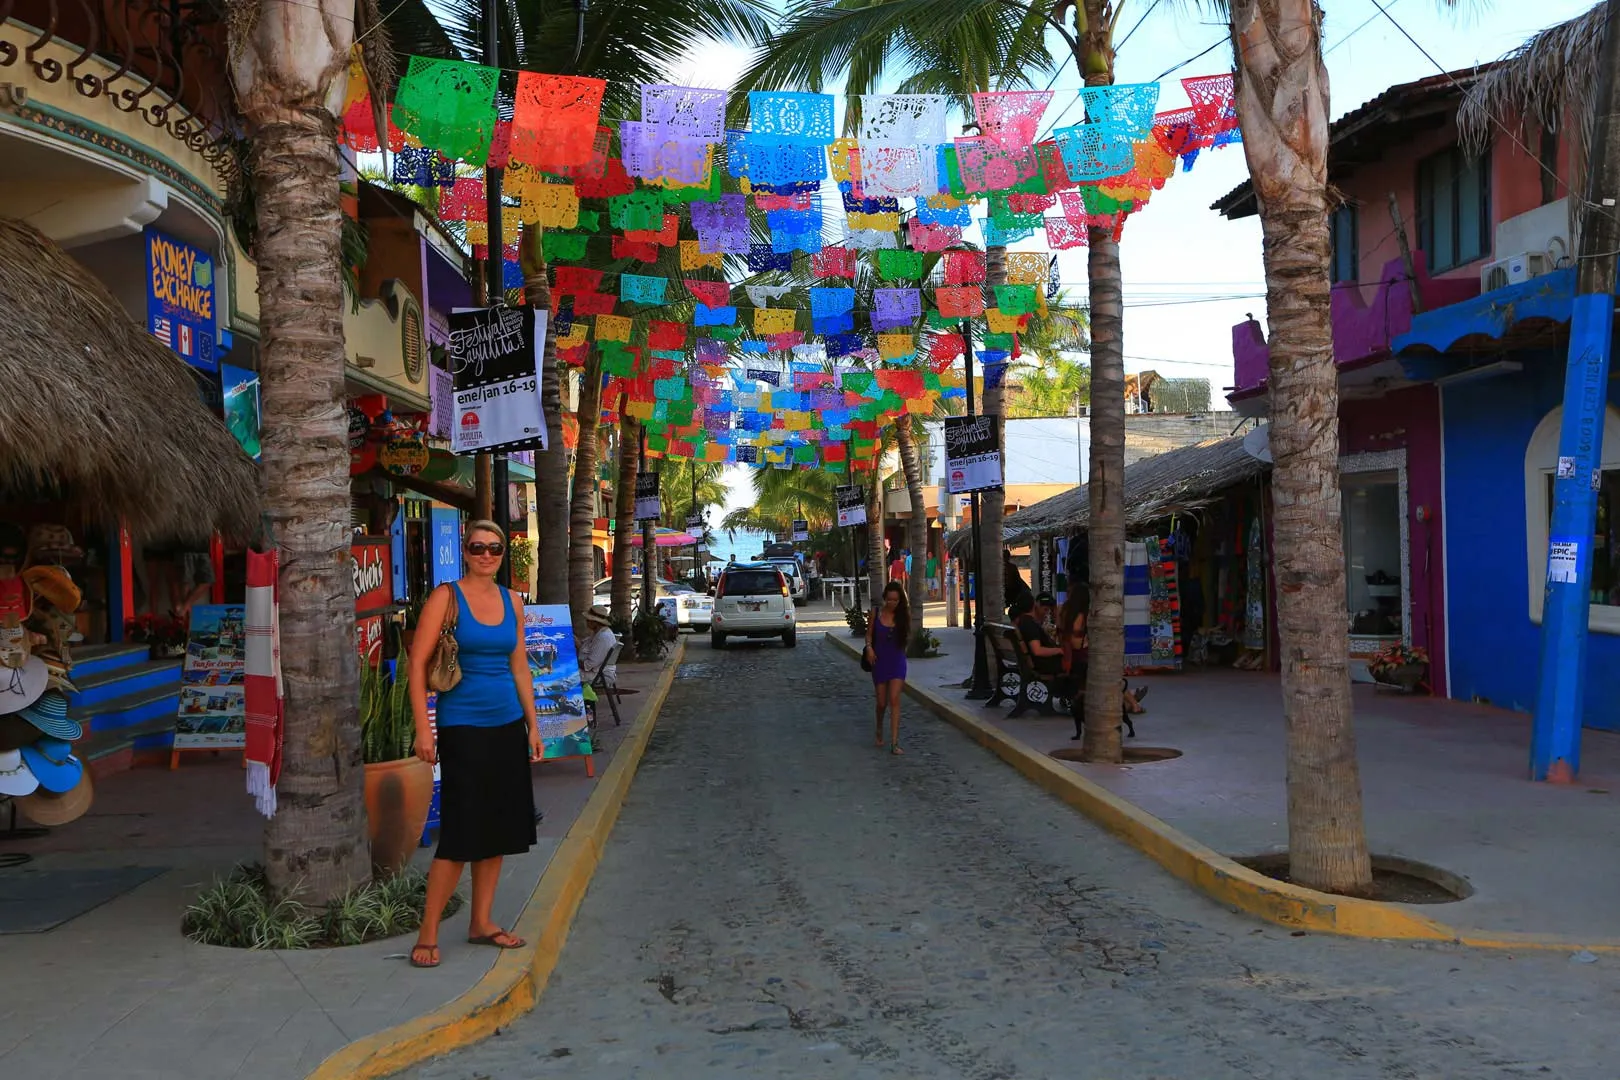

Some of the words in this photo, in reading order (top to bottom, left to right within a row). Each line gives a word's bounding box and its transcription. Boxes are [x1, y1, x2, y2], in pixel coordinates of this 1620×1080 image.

[151, 233, 196, 286] MONEY
[152, 264, 212, 320] EXCHANGE
[448, 307, 509, 354] Festival
[450, 329, 521, 377] Sayulita
[457, 385, 500, 404] ene/jan
[502, 380, 536, 395] 16-19
[949, 457, 977, 467] ene/jan
[978, 454, 999, 463] 16-19
[351, 548, 384, 598] Ruben's
[1553, 548, 1570, 556] EPIC
